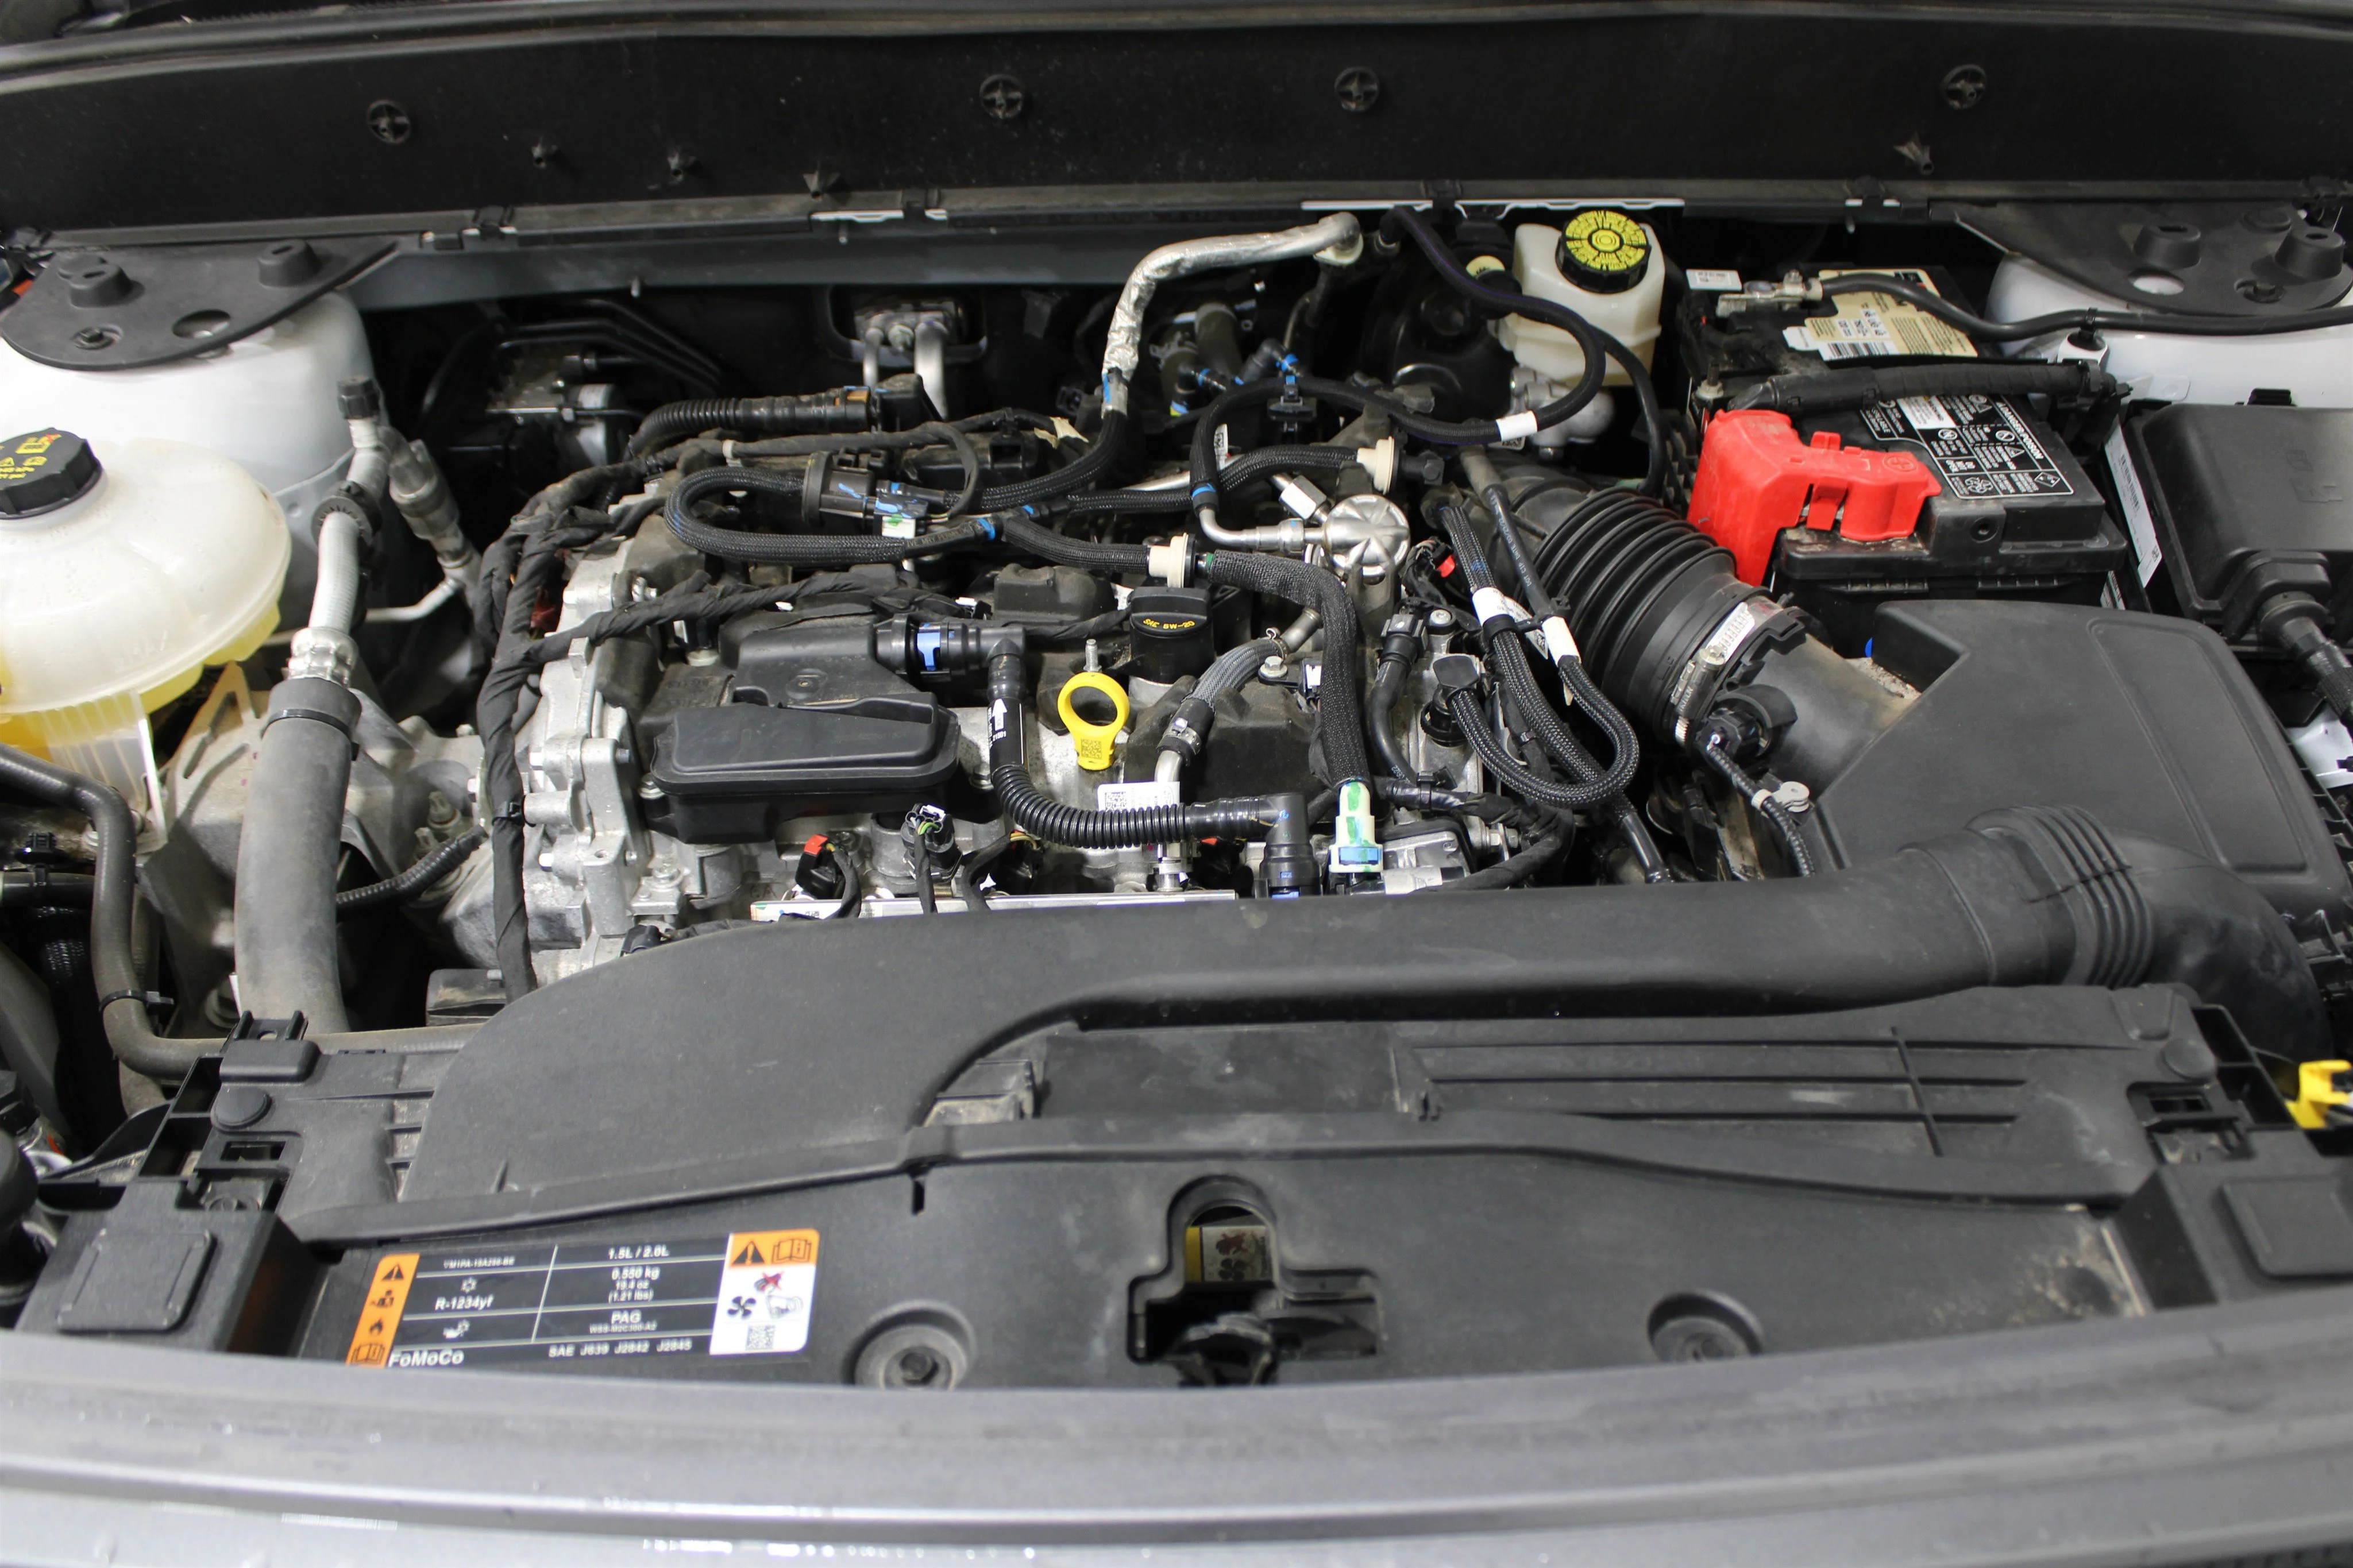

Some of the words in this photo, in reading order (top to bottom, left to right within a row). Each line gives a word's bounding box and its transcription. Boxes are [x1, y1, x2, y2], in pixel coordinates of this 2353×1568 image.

[1511, 543, 1521, 560] DATE
[1523, 575, 1532, 587] DOT
[1143, 618, 1160, 628] SAE
[1163, 620, 1195, 629] 5W-20
[608, 1245, 632, 1260] 1.5L
[643, 1243, 670, 1258] 2.0L
[645, 1265, 661, 1280] kg
[434, 1293, 495, 1311] R-1234yf
[611, 1308, 642, 1324] PAG
[388, 1348, 465, 1368] FoMoCo
[548, 1344, 576, 1358] SAE
